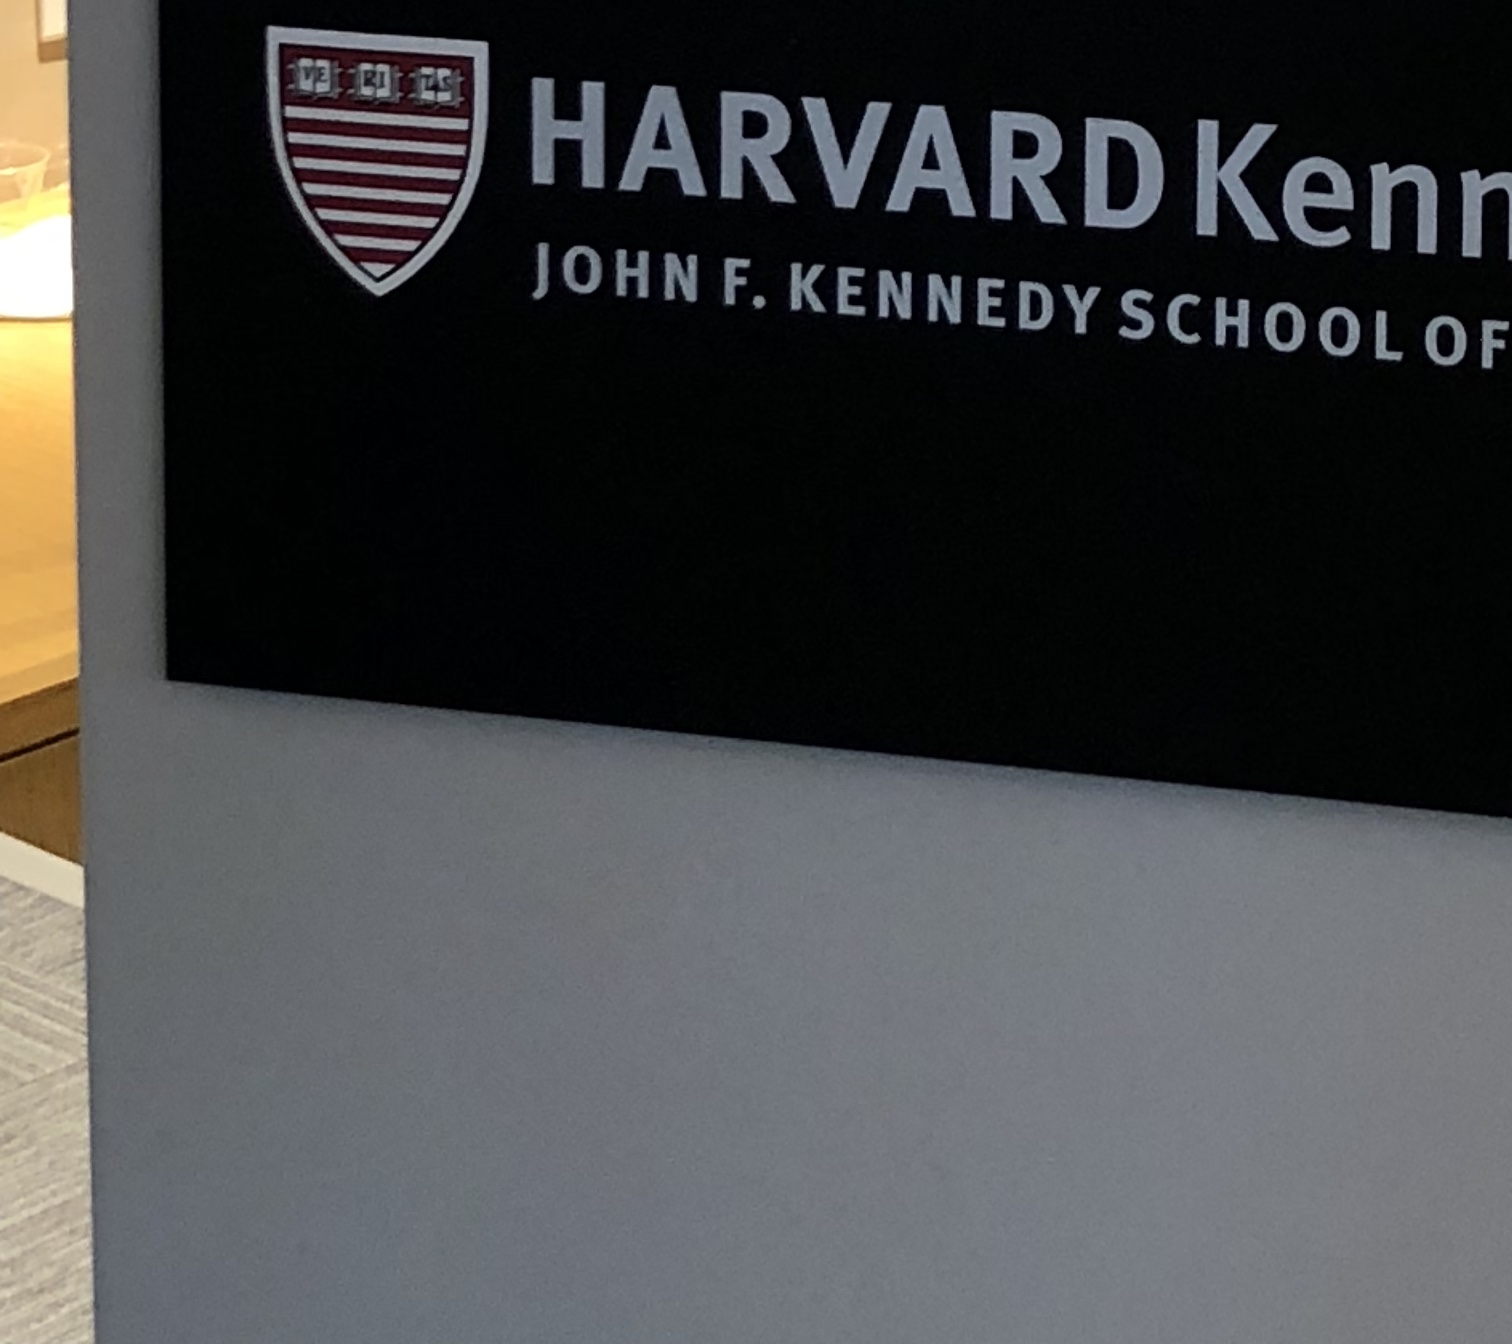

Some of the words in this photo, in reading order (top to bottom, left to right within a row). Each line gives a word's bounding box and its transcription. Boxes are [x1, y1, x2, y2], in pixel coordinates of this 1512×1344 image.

[531, 77, 1165, 230] HARVARD
[531, 241, 699, 304] JOHN
[723, 257, 767, 310] F.
[789, 261, 1102, 335] KENNEDY
[1117, 288, 1404, 362] SCHOOL
[1423, 314, 1511, 370] OF
